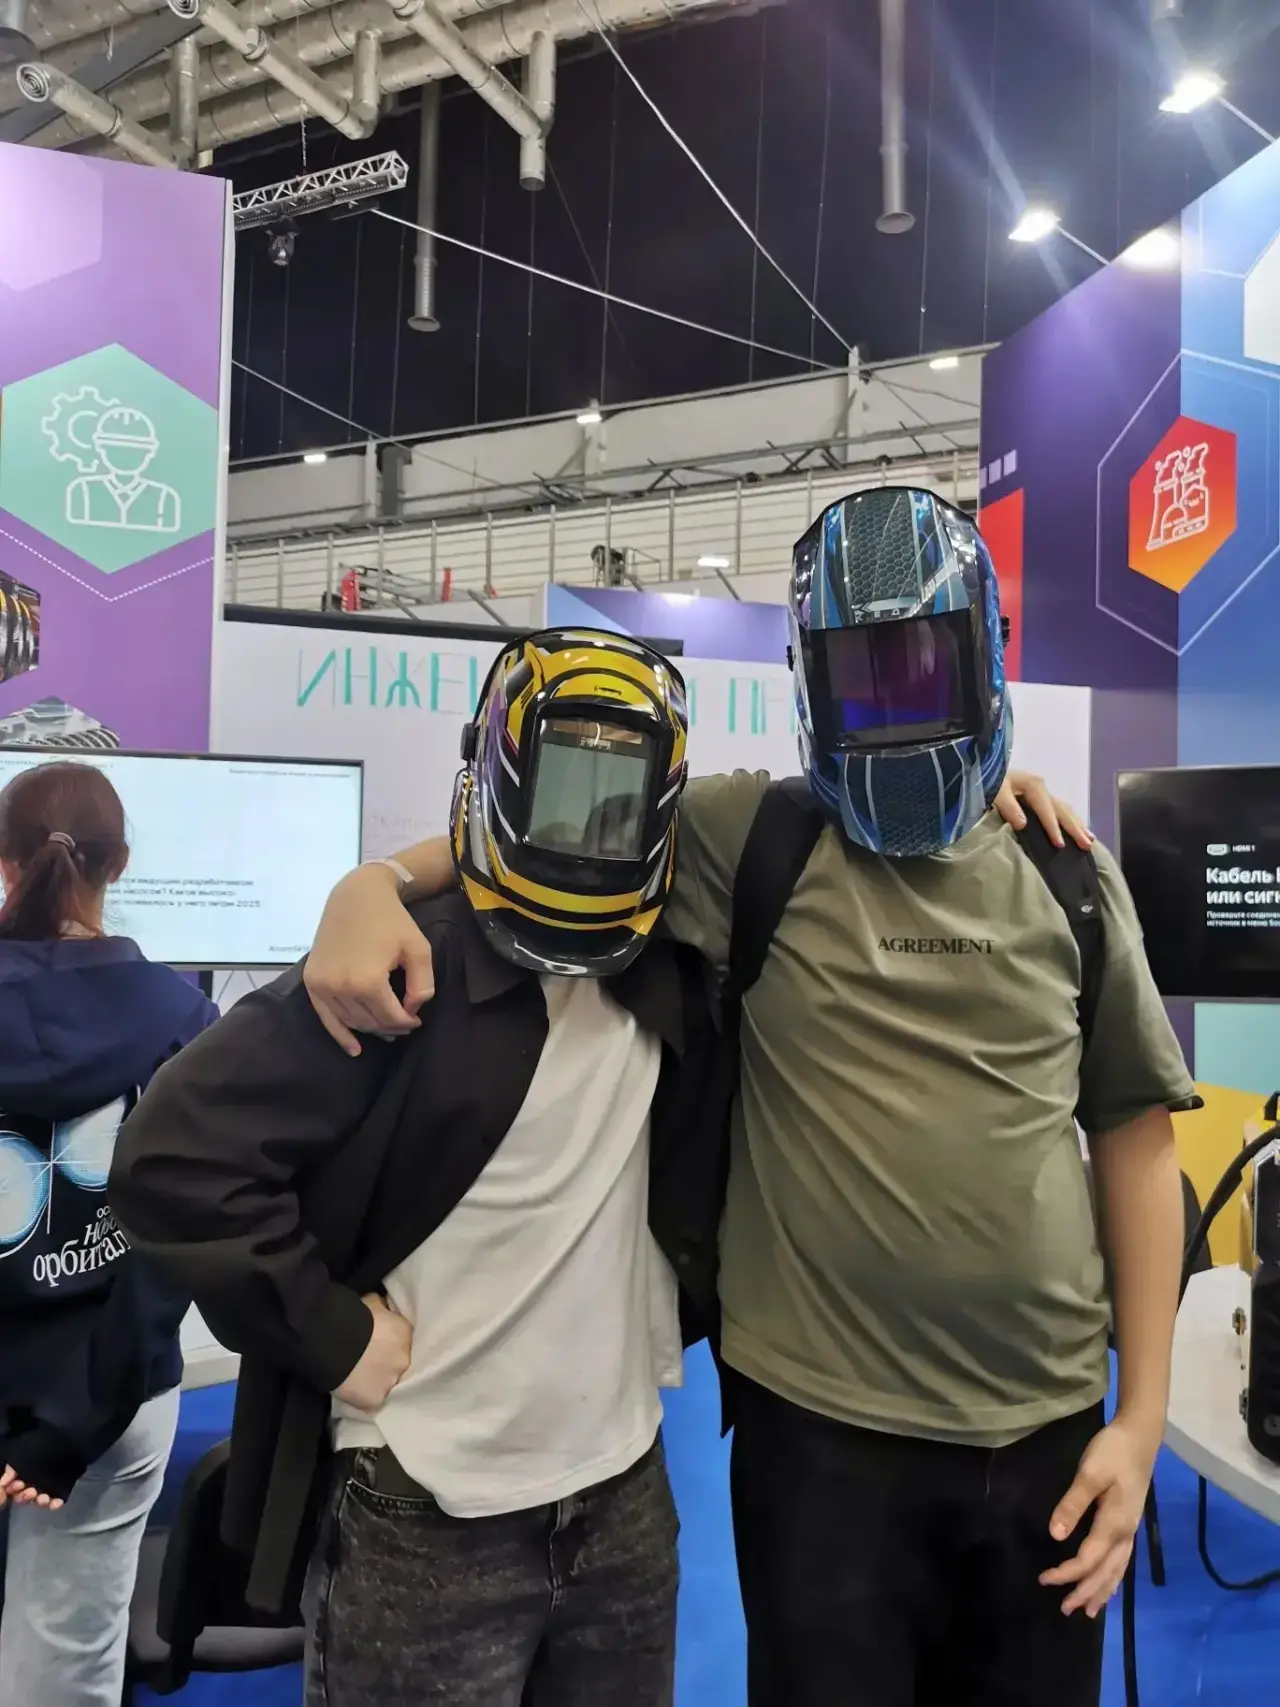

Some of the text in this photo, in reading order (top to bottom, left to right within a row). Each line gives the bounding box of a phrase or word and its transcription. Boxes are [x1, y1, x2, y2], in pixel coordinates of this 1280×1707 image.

[1206, 867, 1275, 884] Кабель
[1206, 890, 1242, 904] или
[878, 936, 995, 954] AGREEMENT
